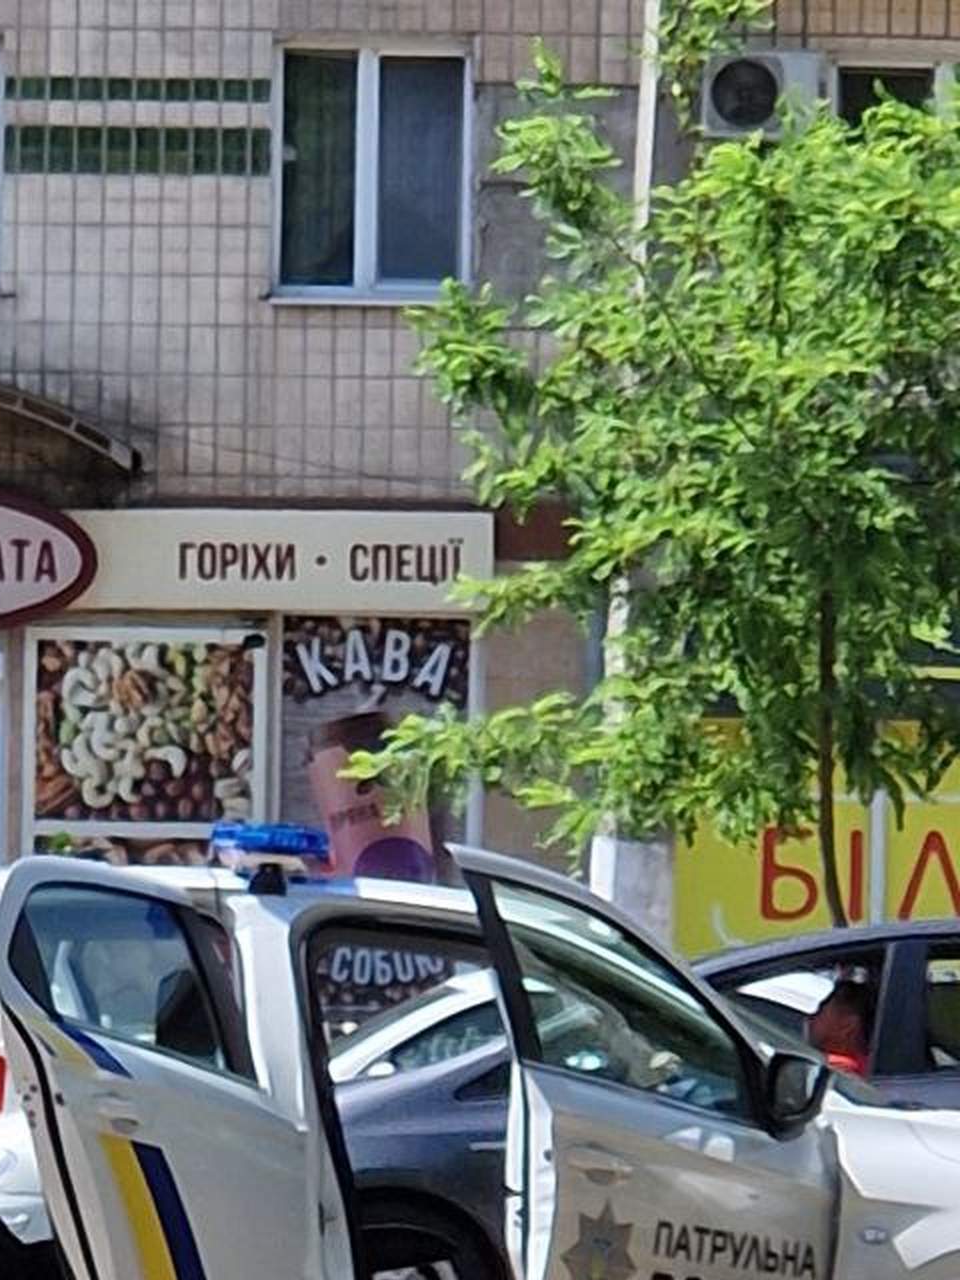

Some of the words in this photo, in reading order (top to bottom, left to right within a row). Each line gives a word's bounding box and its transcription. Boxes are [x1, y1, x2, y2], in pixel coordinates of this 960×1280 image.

[179, 542, 296, 581] ГОРІХИ
[349, 538, 464, 585] СПЕЦІЇ
[297, 629, 453, 697] КАВА
[653, 1220, 816, 1280] ПАТРУЛЬНА
